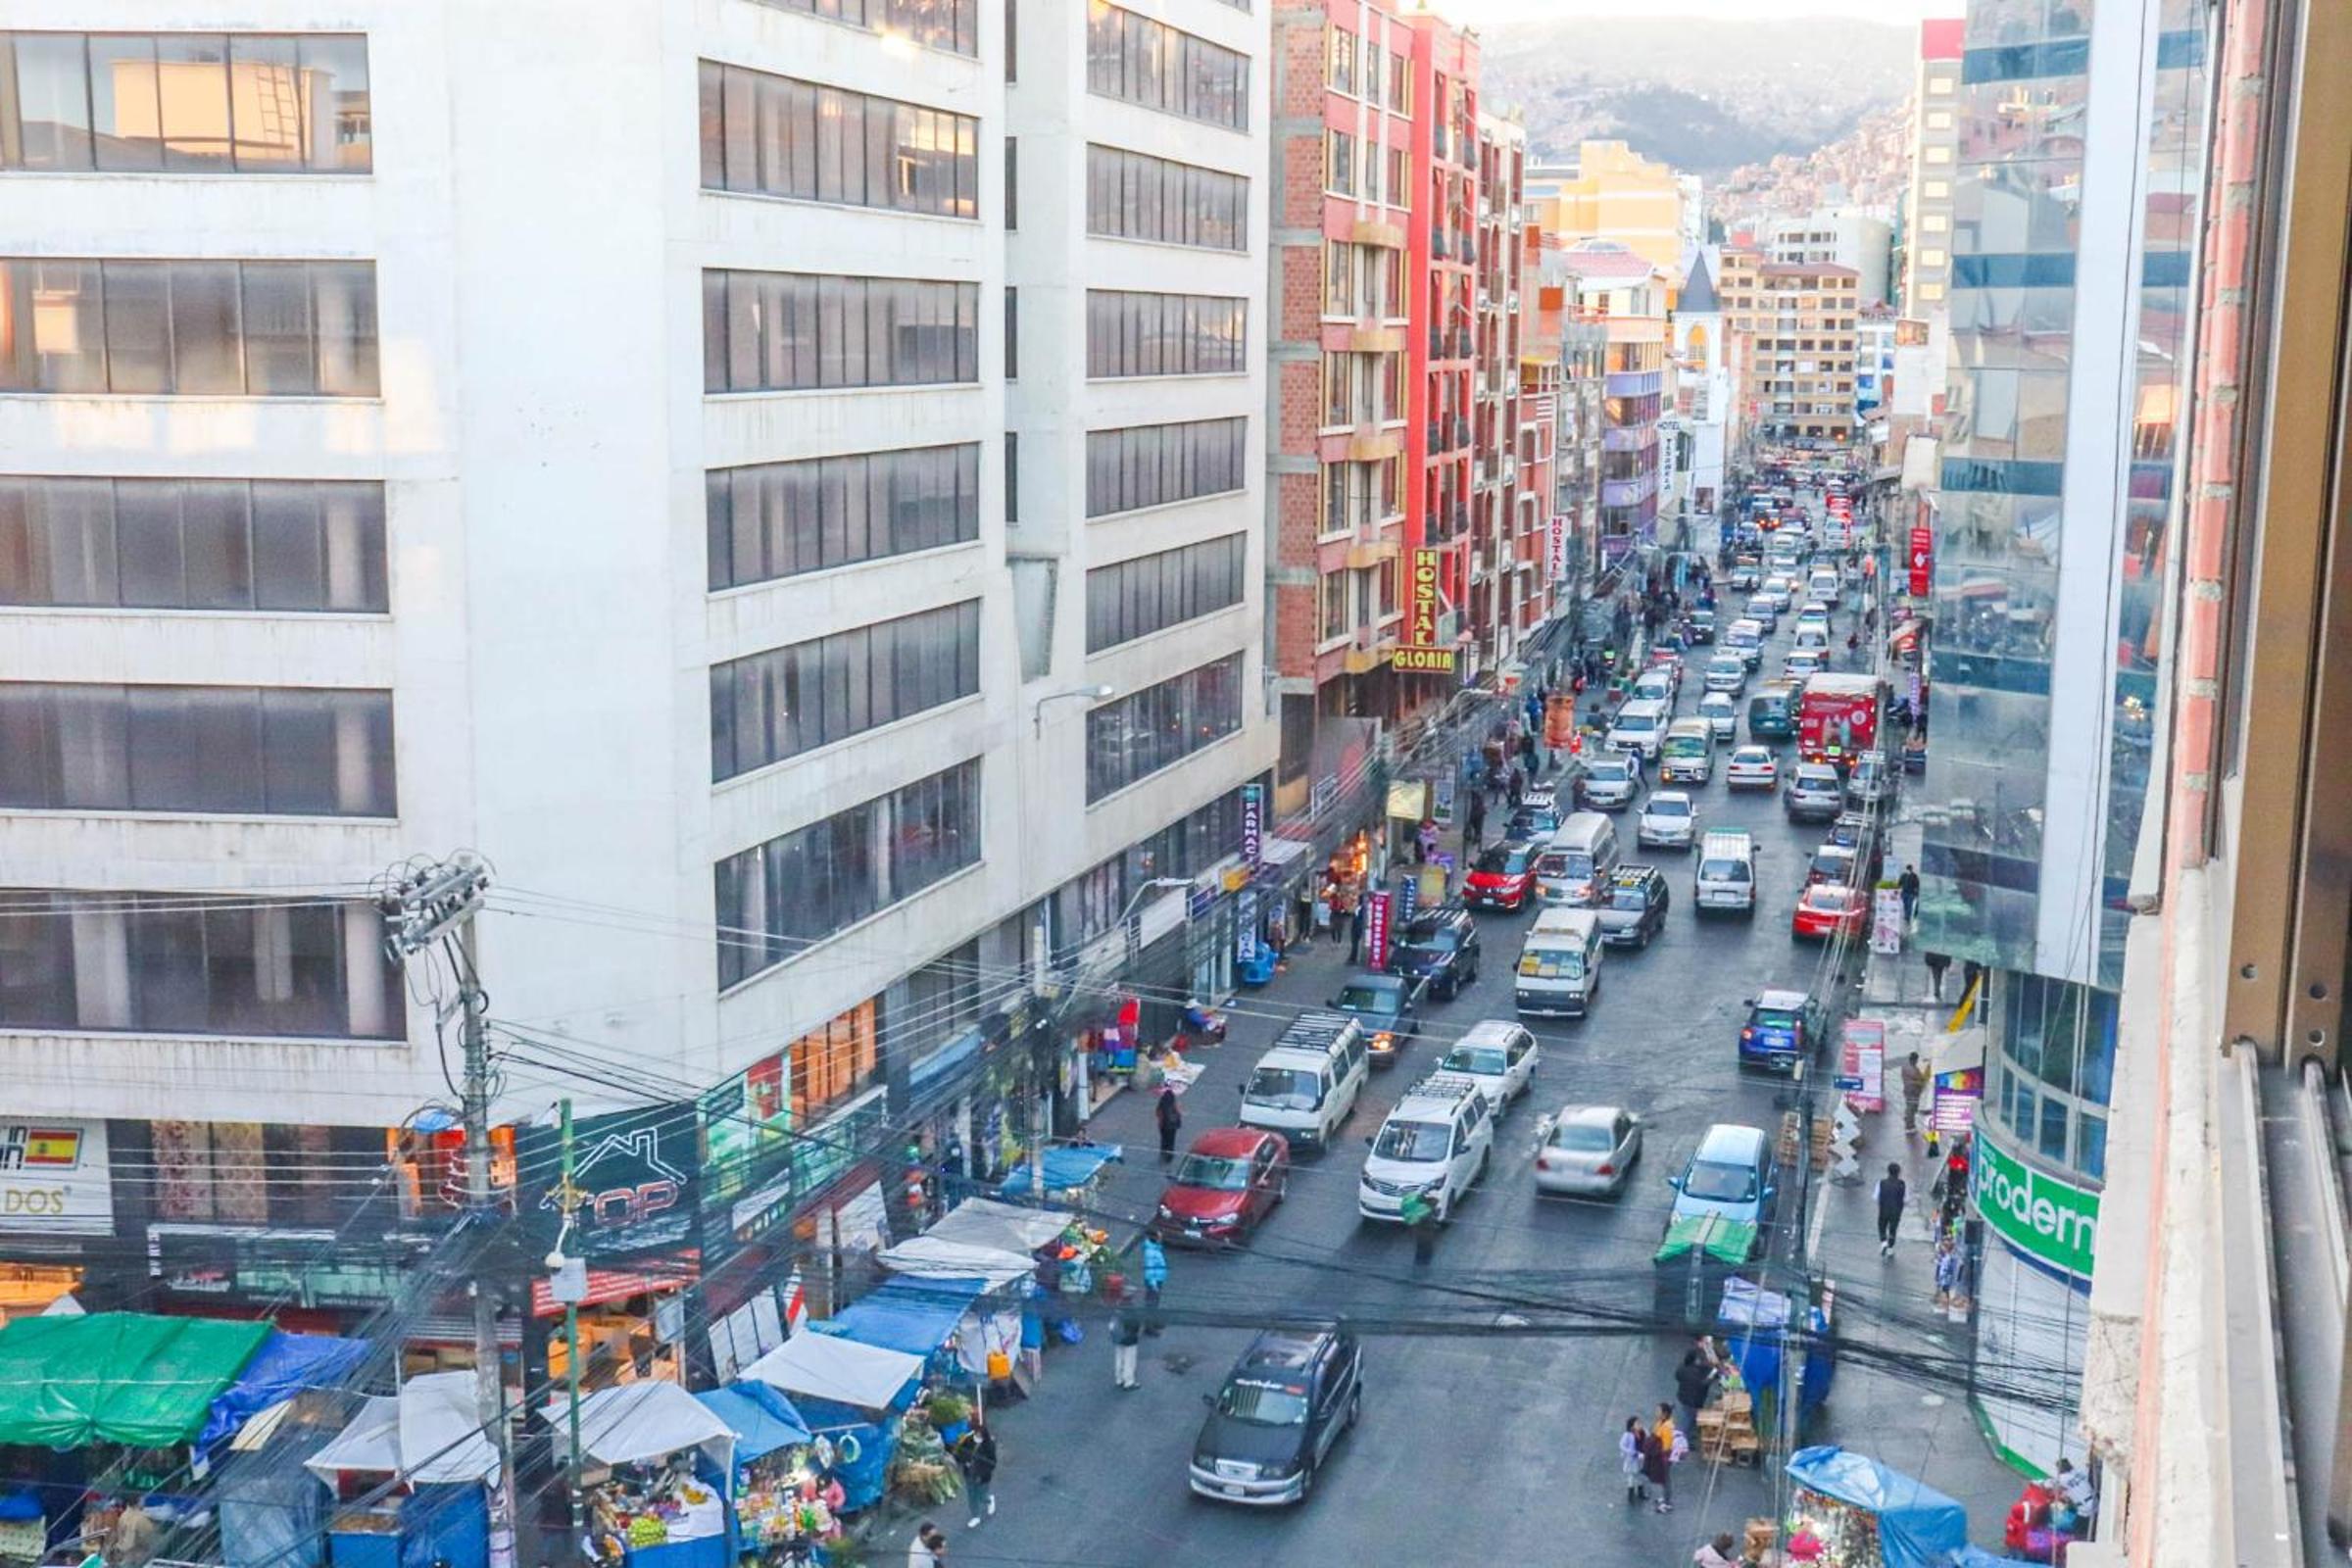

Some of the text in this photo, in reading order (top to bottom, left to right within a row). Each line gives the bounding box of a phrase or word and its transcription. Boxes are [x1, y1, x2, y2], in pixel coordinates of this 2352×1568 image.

[1552, 517, 1562, 572] HOSTAL
[1415, 551, 1436, 646] HOSTAL
[1395, 650, 1451, 668] GLORIA
[1244, 802, 1257, 867] FARMACI
